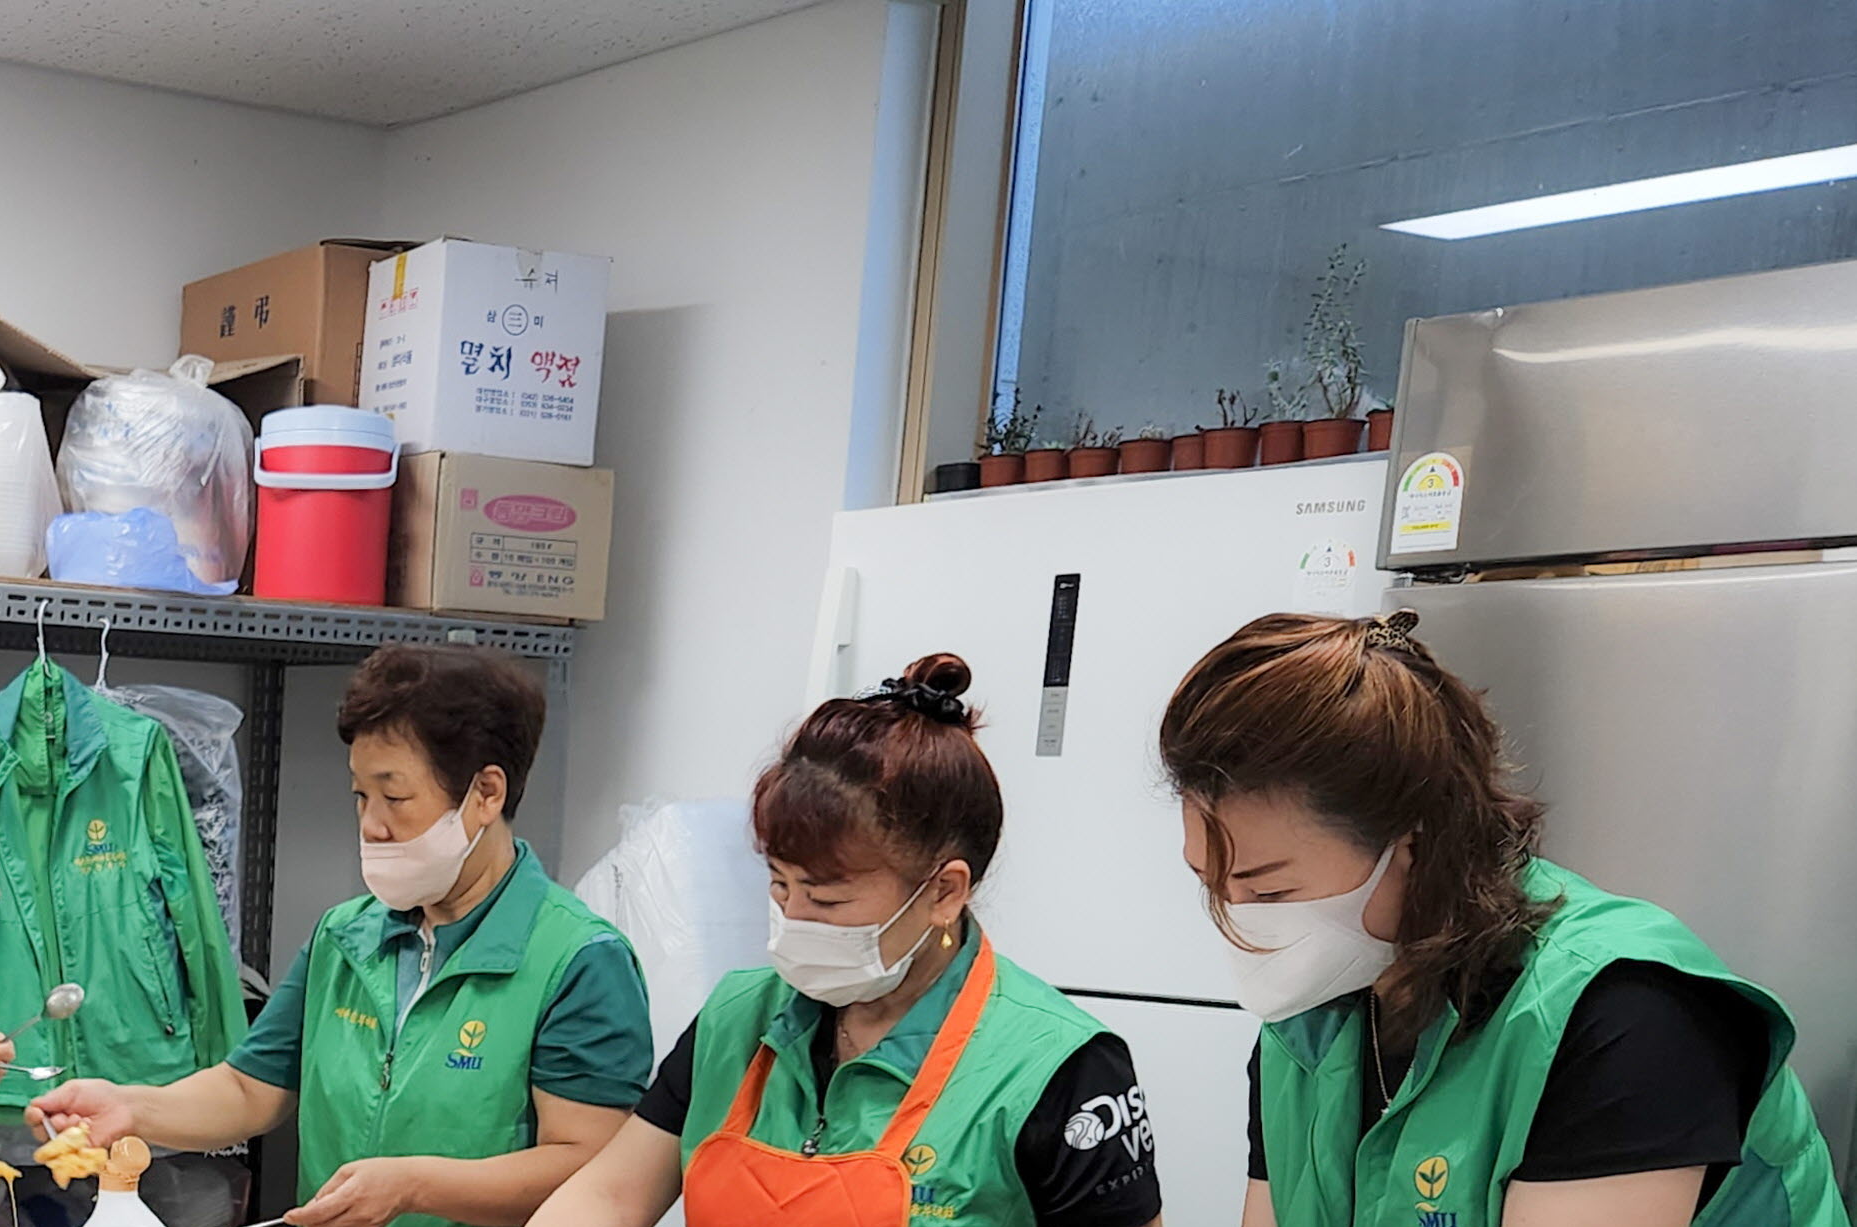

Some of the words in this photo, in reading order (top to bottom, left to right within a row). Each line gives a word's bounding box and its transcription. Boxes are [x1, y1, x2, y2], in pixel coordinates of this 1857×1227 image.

[460, 340, 512, 381] 멸치
[530, 351, 581, 388] 액젓
[1295, 500, 1367, 515] SAMSUNG
[445, 1053, 484, 1070] SMU
